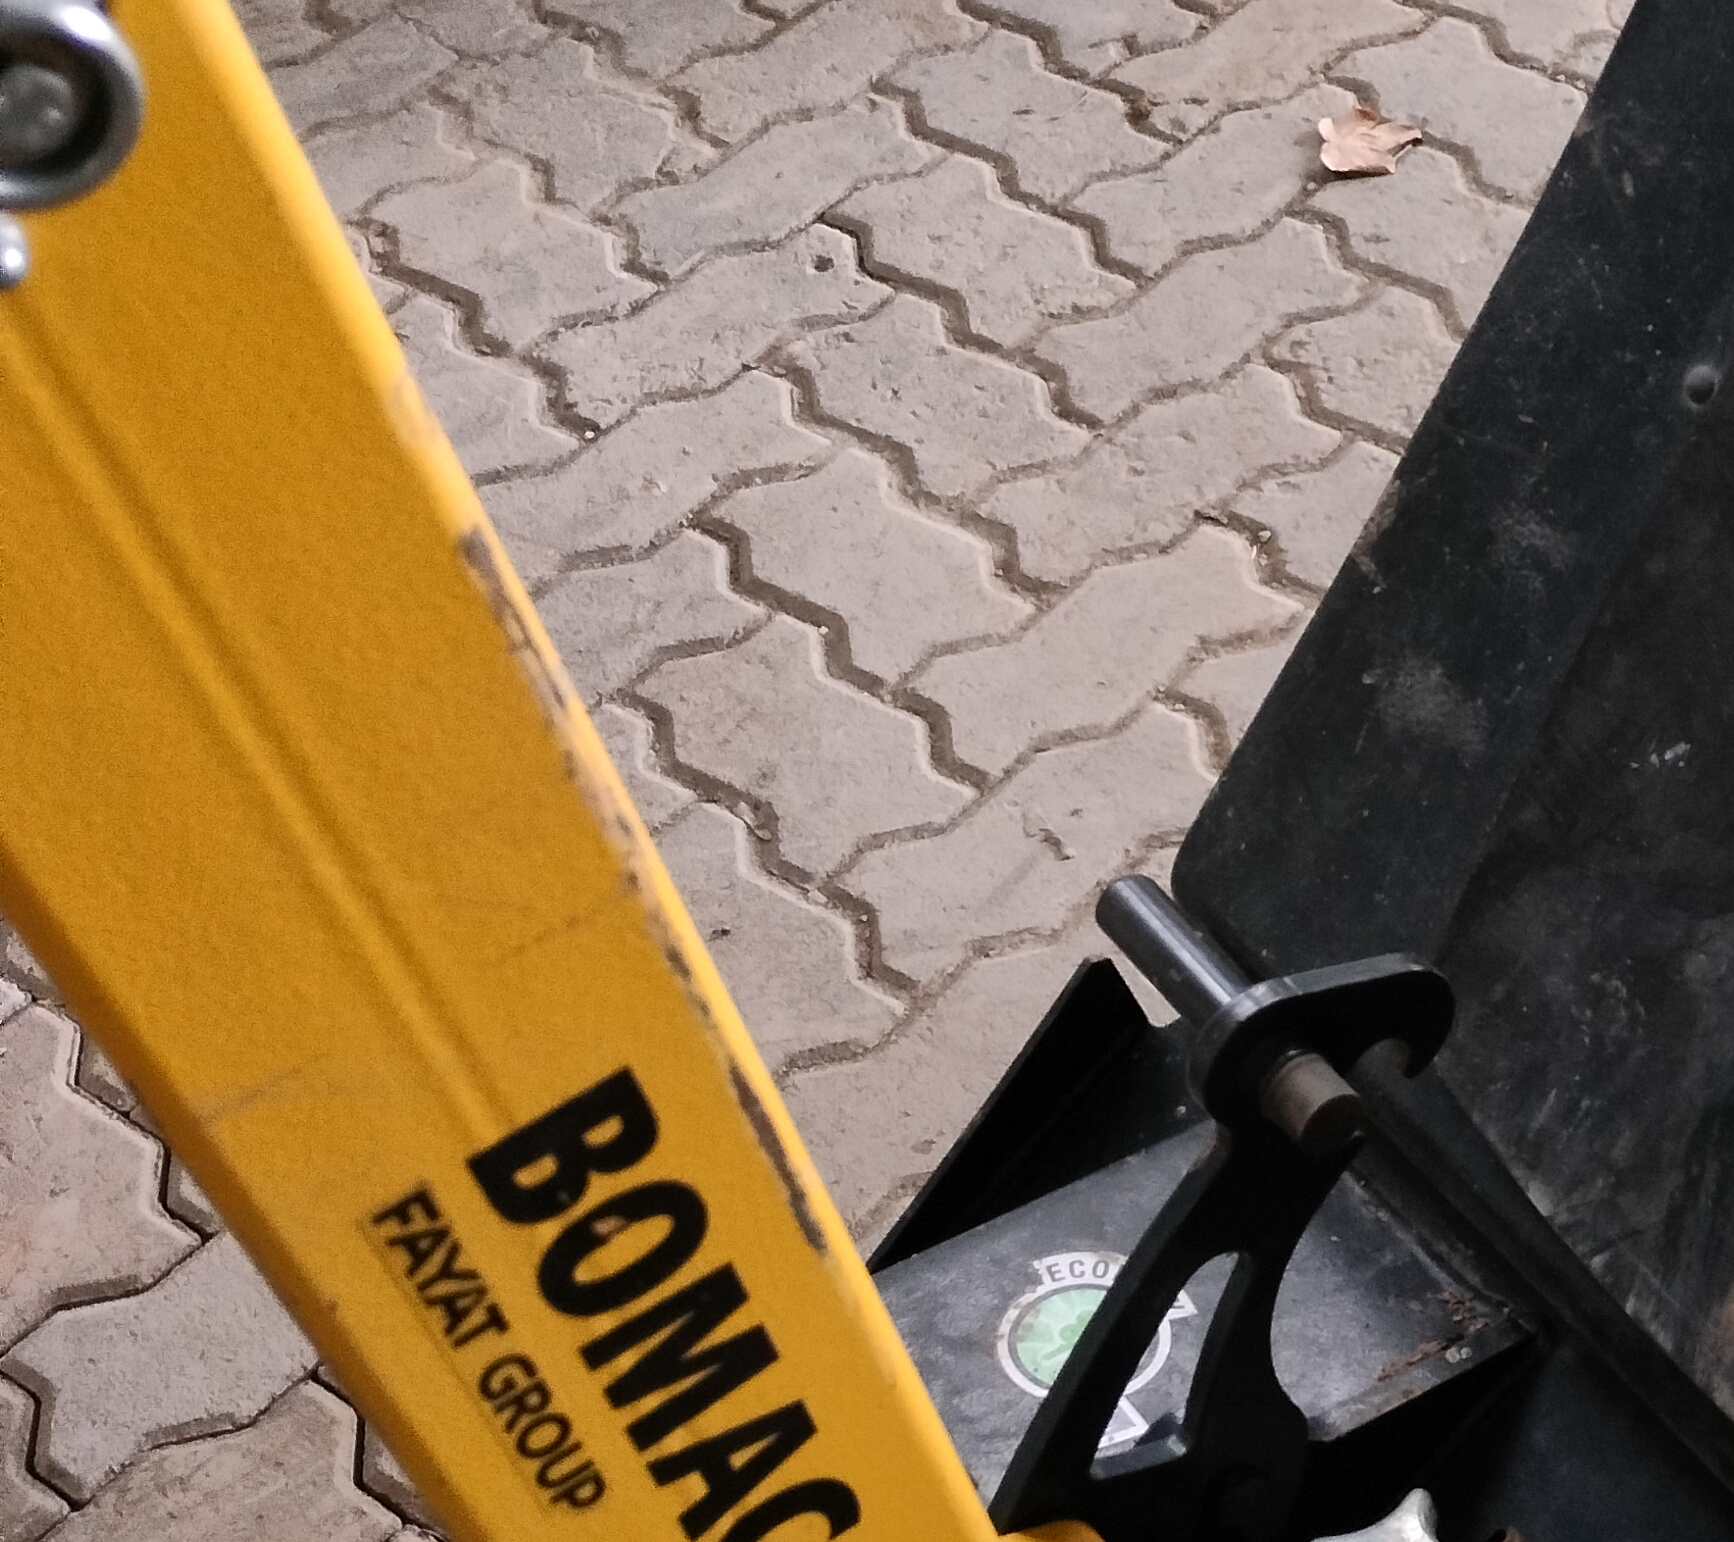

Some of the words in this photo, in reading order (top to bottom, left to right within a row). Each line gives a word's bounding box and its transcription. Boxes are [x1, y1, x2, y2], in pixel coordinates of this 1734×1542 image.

[371, 1184, 509, 1349] FAYAT
[477, 1353, 607, 1510] GROUP
[1045, 1260, 1110, 1283] ECO
